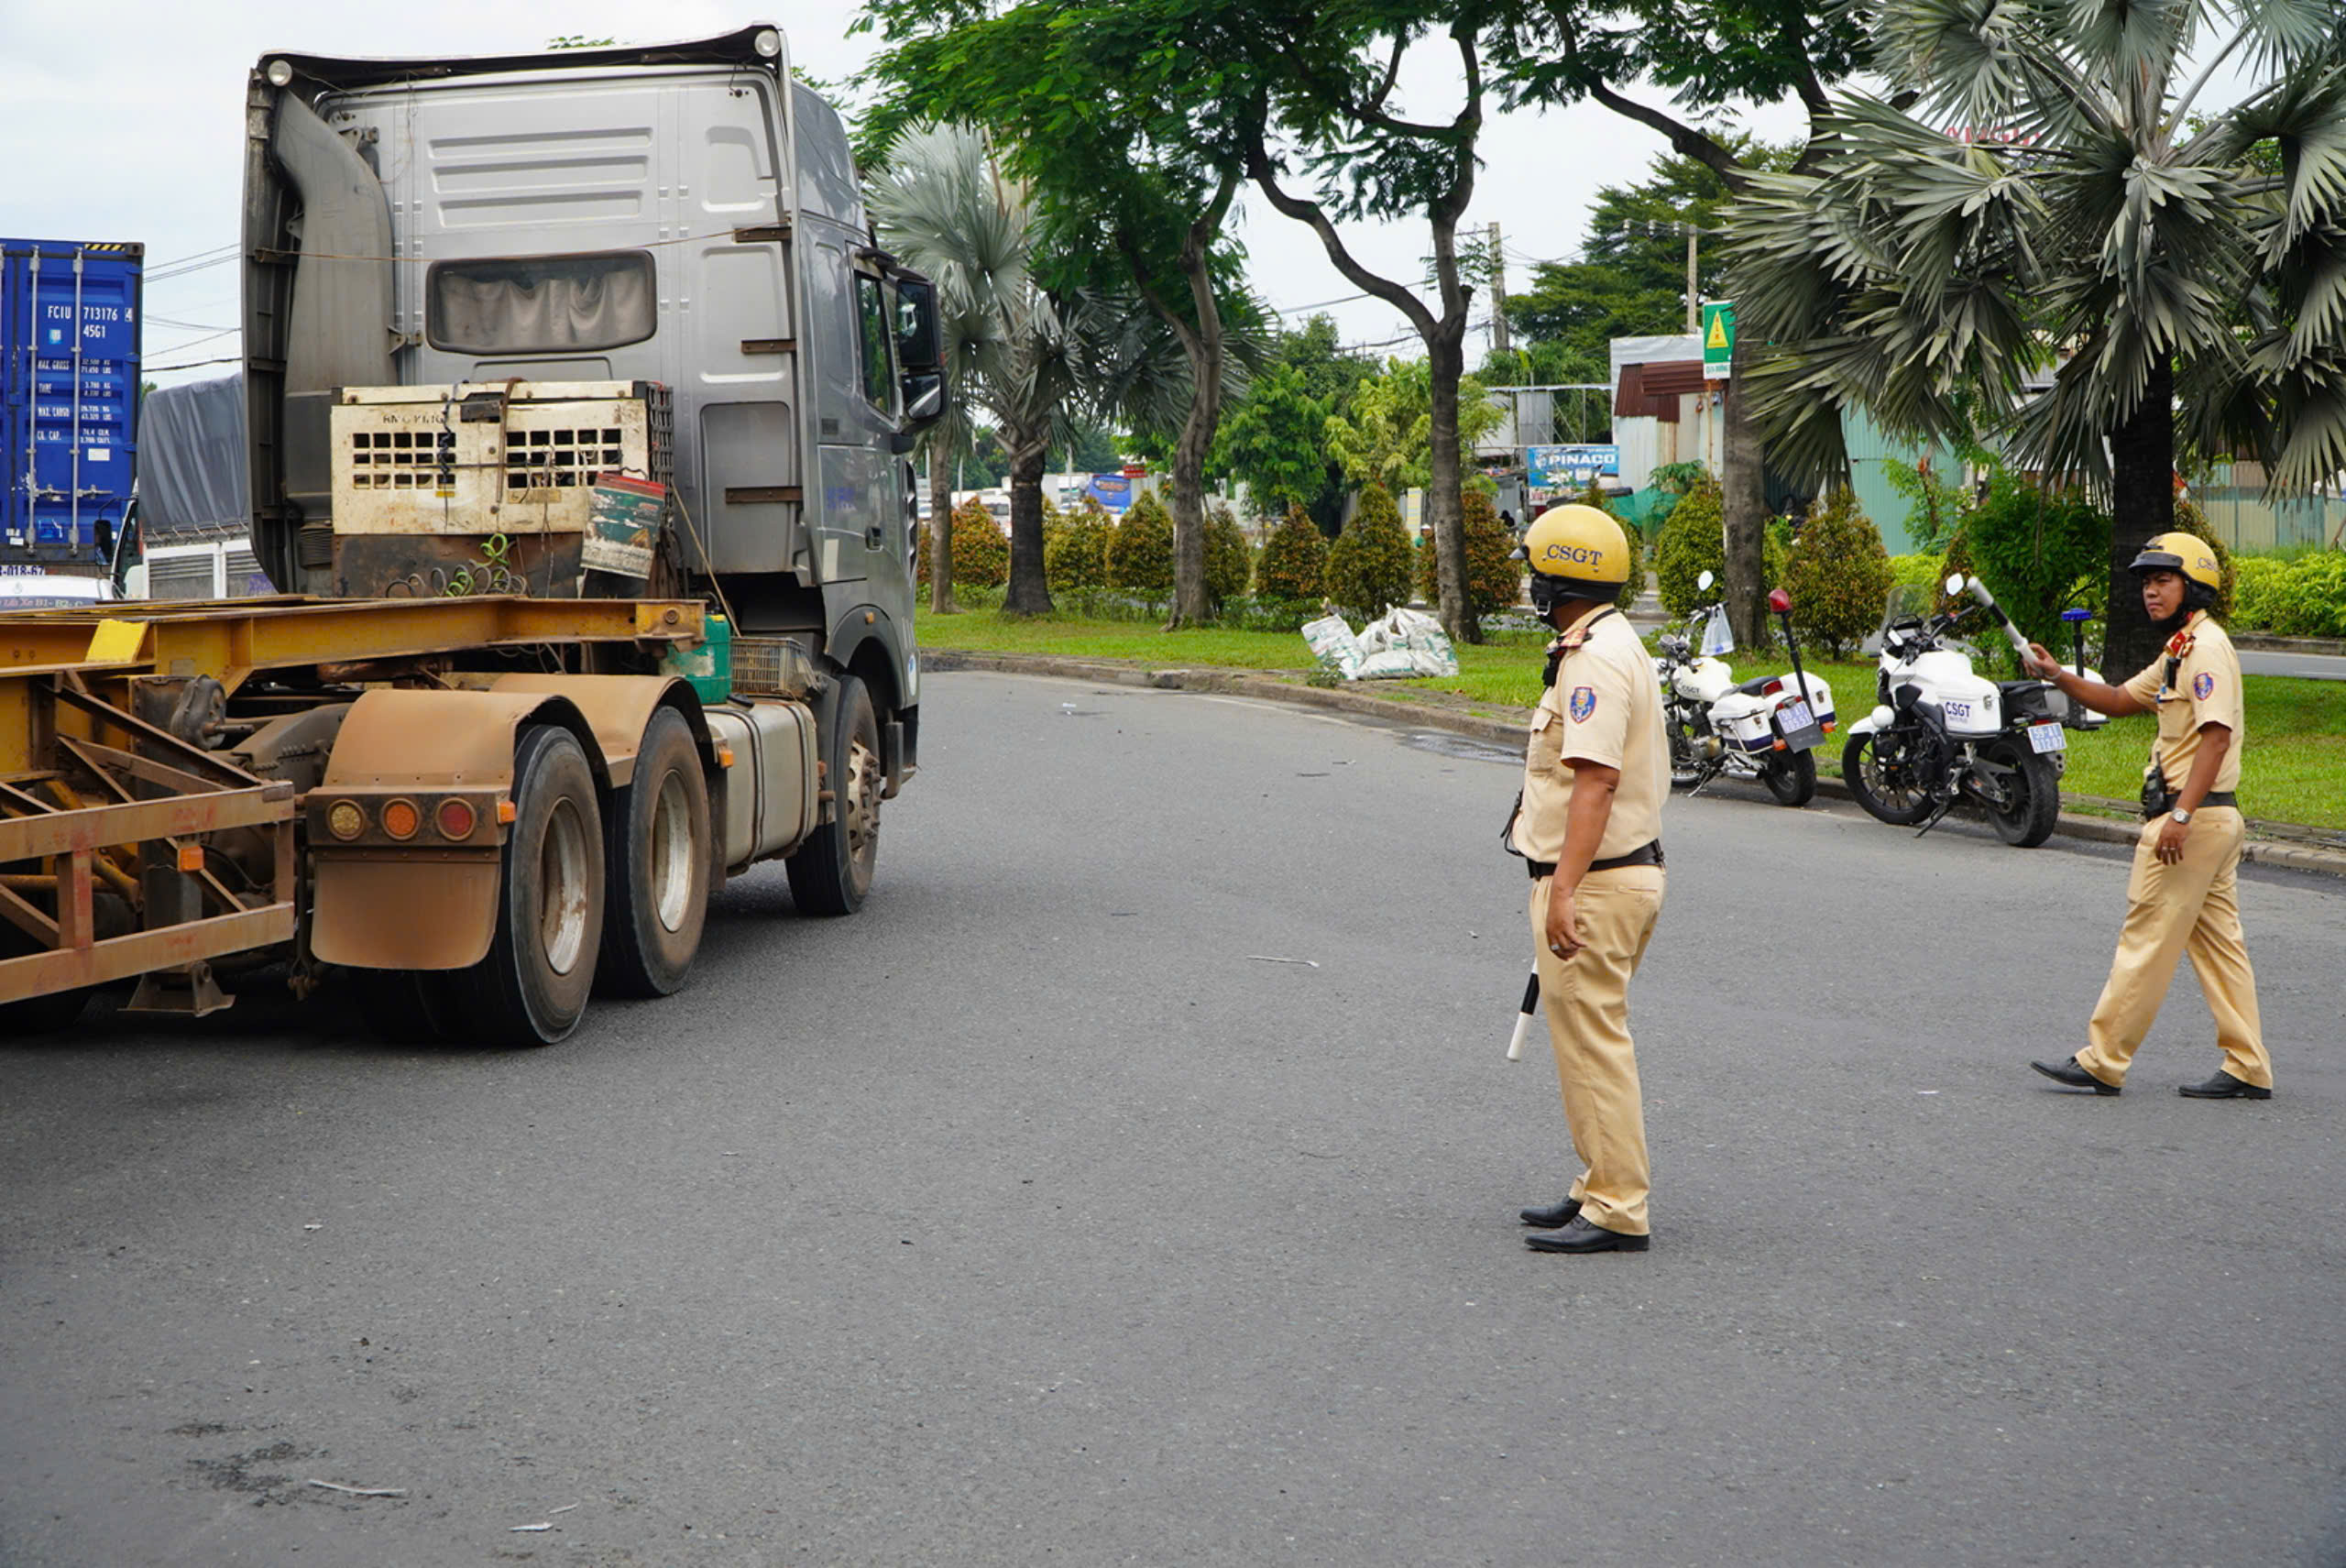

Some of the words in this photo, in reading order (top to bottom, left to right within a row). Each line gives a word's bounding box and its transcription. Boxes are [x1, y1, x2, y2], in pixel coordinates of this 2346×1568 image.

[48, 305, 71, 319] FCIU
[83, 306, 118, 321] 713176
[125, 307, 133, 322] 4
[83, 323, 105, 338] 45G1
[1549, 454, 1616, 465] PINACO
[1547, 543, 1603, 565] CSGT
[1945, 701, 1971, 718] CSGT
